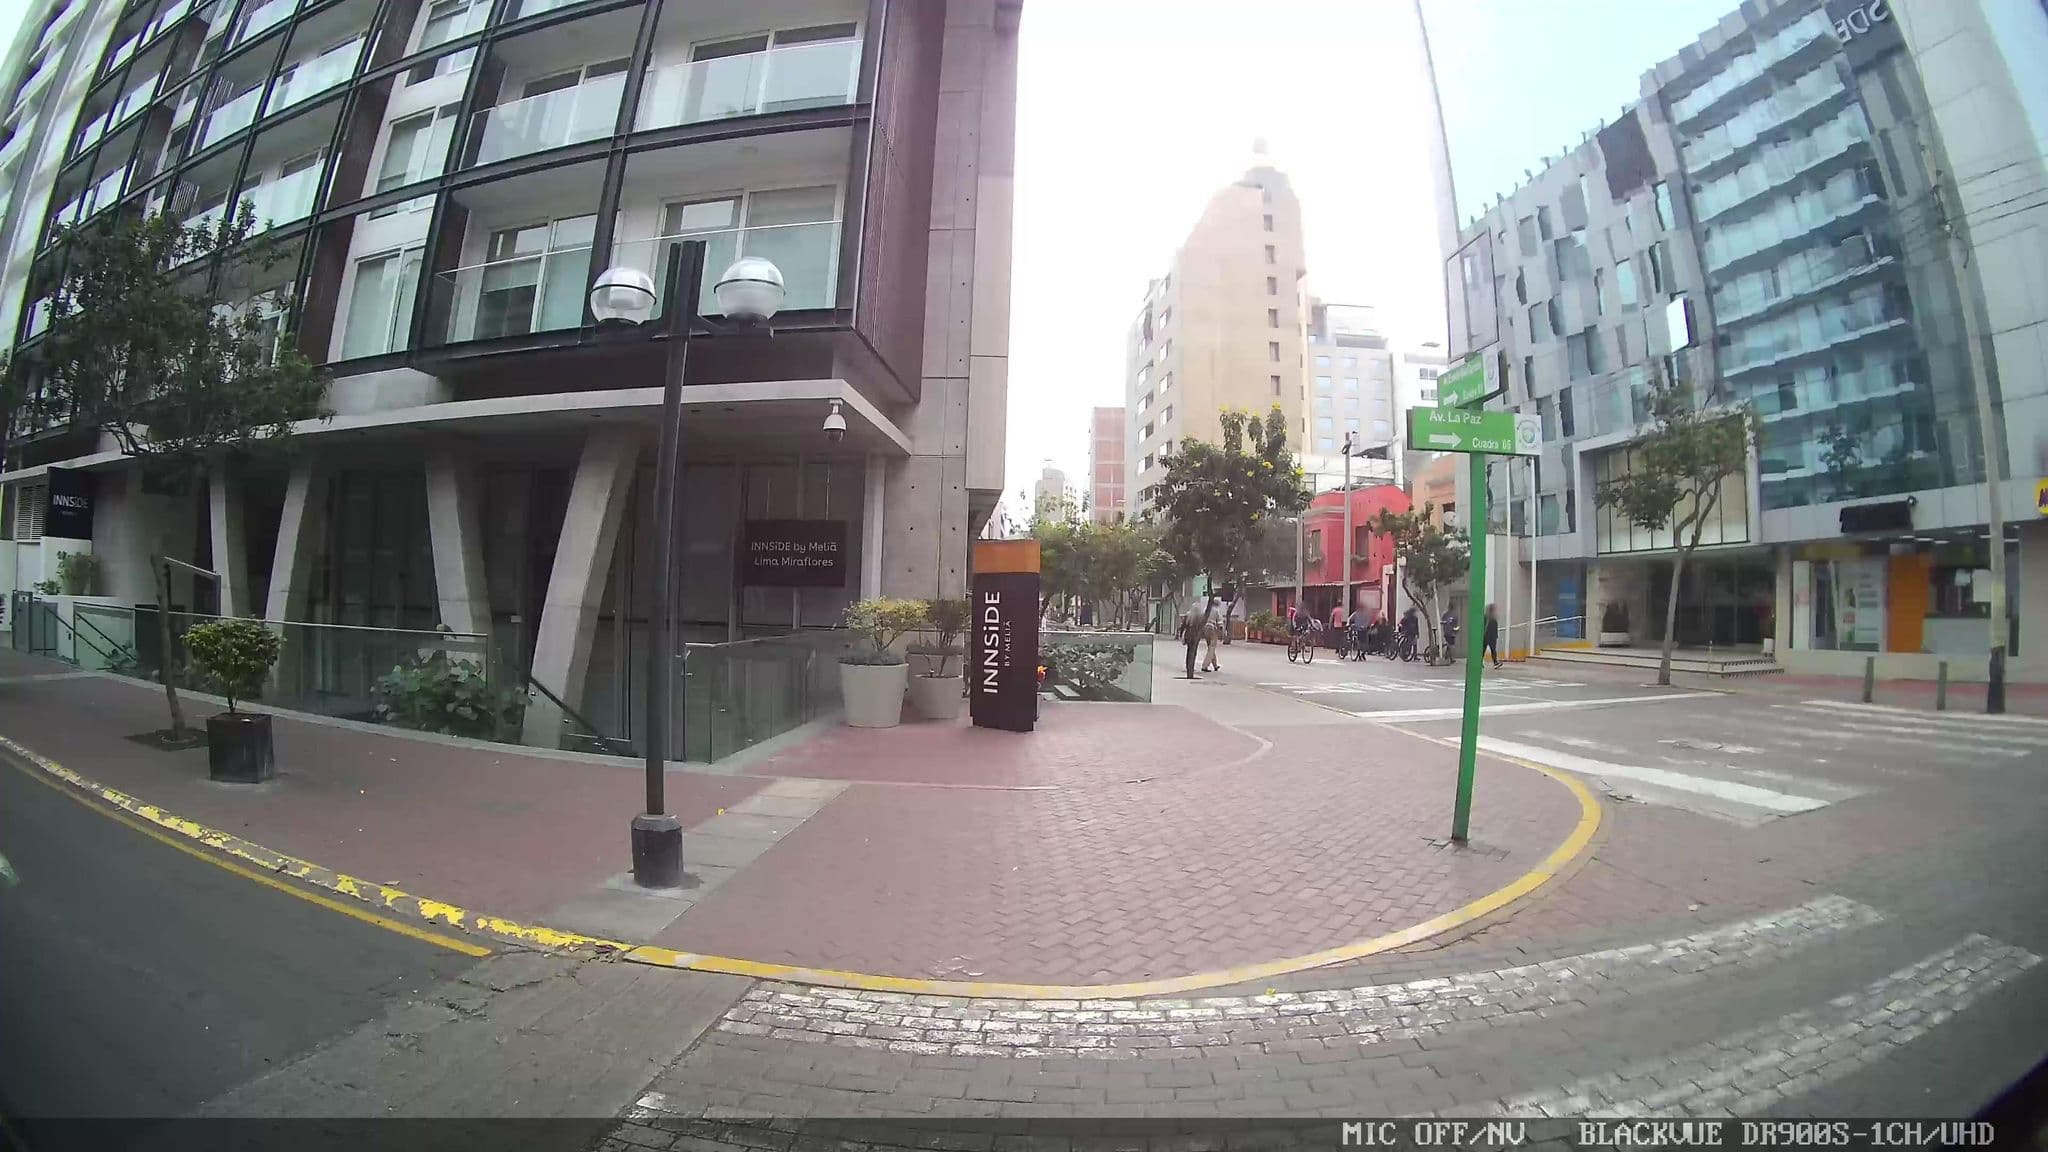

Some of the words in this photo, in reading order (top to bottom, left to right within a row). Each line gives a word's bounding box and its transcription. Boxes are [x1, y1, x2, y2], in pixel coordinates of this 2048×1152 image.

[1429, 410, 1445, 422] Av.
[1448, 412, 1461, 423] La
[1463, 413, 1483, 425] Paz
[1472, 437, 1499, 449] Cuadra
[793, 542, 806, 554] by
[754, 556, 779, 566] Lima
[781, 556, 834, 567] Miraflores
[1004, 655, 1011, 667] BY
